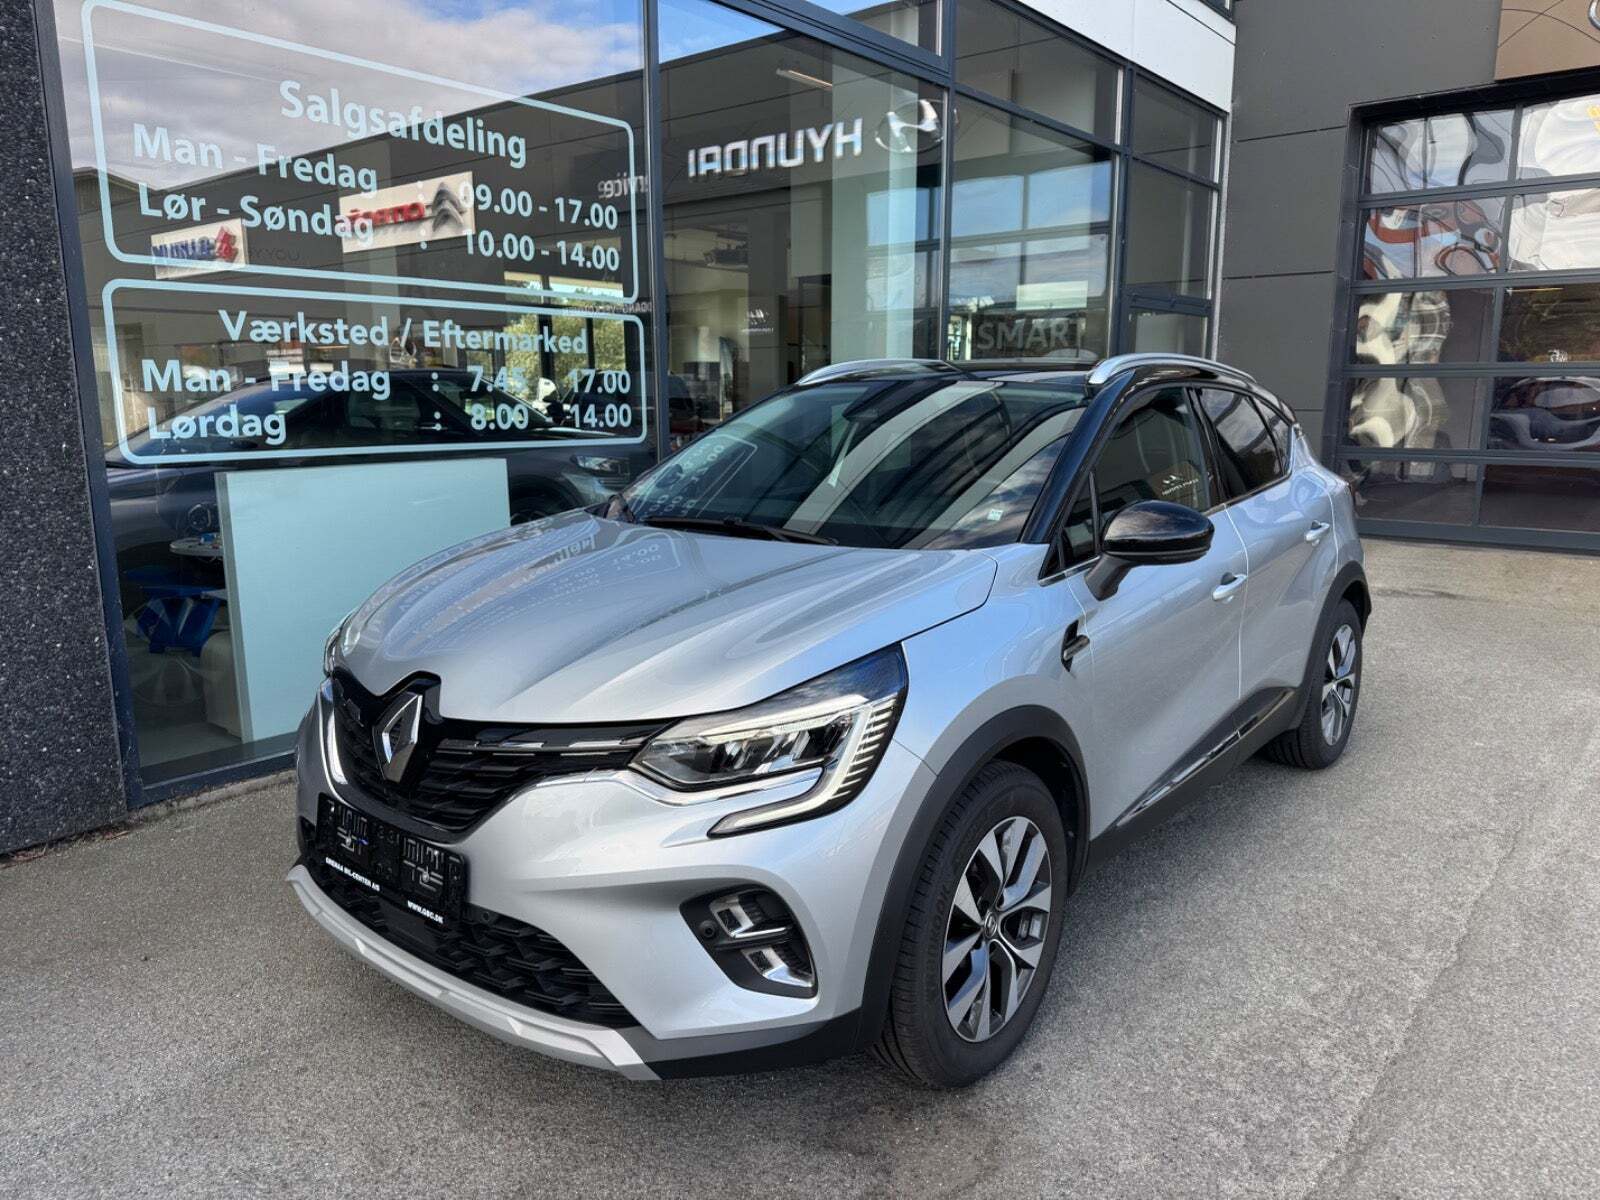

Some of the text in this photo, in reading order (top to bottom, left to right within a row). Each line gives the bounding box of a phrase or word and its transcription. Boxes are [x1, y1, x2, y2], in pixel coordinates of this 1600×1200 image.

[279, 79, 528, 169] Salgsafdeling
[133, 122, 224, 170] Man
[257, 143, 378, 196] Fredag
[457, 181, 533, 218] 09.00
[554, 196, 619, 231] 17.00
[137, 182, 209, 222] Lør
[240, 194, 374, 247] Søndag
[463, 228, 536, 262] 10.00
[556, 239, 621, 272] 14.00
[218, 309, 390, 347] Værksted
[423, 320, 589, 355] Eftermarked
[976, 316, 1087, 352] SMART
[142, 359, 231, 393] Man
[269, 360, 392, 402] Fredag
[469, 365, 526, 393] 7.45
[568, 369, 632, 396] 17.00
[147, 402, 287, 444] Lørdag
[470, 403, 530, 431] 8.00
[569, 403, 633, 429] 14.00
